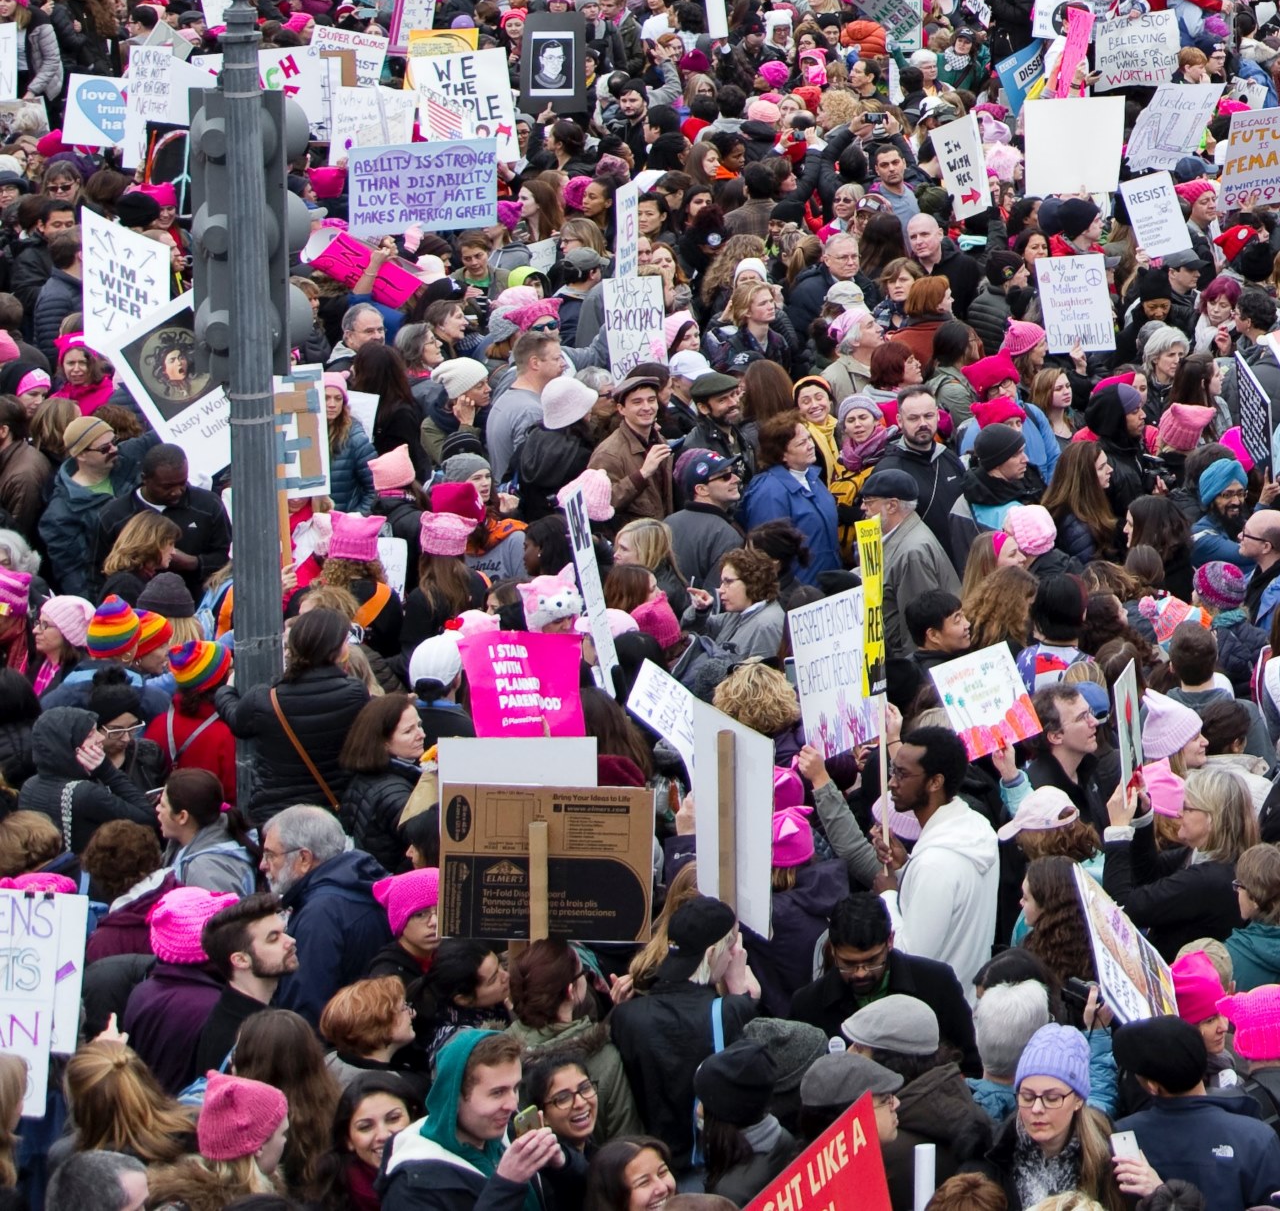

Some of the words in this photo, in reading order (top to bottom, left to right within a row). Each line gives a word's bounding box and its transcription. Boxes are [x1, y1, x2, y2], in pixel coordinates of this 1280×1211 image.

[1233, 116, 1278, 130] BECAUSE
[354, 154, 412, 174] ABILITY
[416, 155, 431, 169] IS
[435, 151, 496, 168] STRONGER
[355, 175, 399, 192] THAN
[358, 192, 399, 207] LOVE
[407, 191, 436, 204] NOT
[444, 187, 486, 202] HATE
[354, 209, 395, 225] MAKES
[399, 207, 452, 223] AMERICA
[109, 259, 137, 282] I'M
[99, 270, 148, 306] WITH
[105, 292, 142, 319] HER
[553, 793, 571, 801] Bring
[573, 793, 589, 801] Your
[591, 794, 609, 802] Ideas
[487, 874, 524, 883] ELMER'S
[806, 1130, 849, 1197] LIKE
[852, 1119, 867, 1155] A
